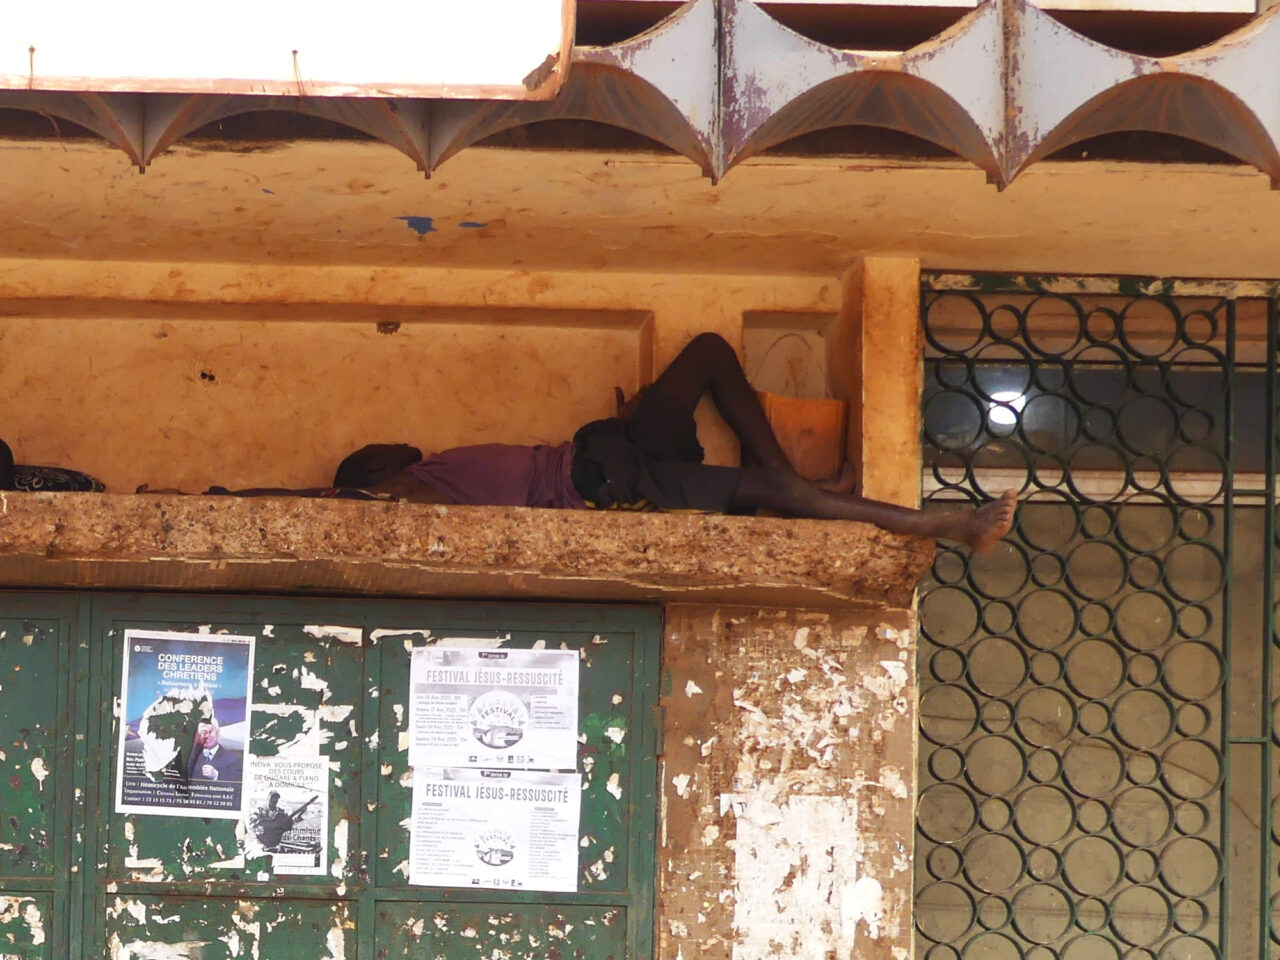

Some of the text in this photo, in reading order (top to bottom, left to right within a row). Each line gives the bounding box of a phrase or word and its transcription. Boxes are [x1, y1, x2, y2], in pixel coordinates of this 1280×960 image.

[158, 653, 224, 665] CONFERENCE
[158, 662, 223, 673] DES LEADERS
[163, 671, 217, 681] CHRETIENS
[426, 668, 564, 685] FESTIVAL JÉSUS-RESSUSCITÉ
[480, 706, 516, 721] FESTIVAL
[426, 782, 569, 804] FESTIVAL JÉSUS-RESSUSCITÉ
